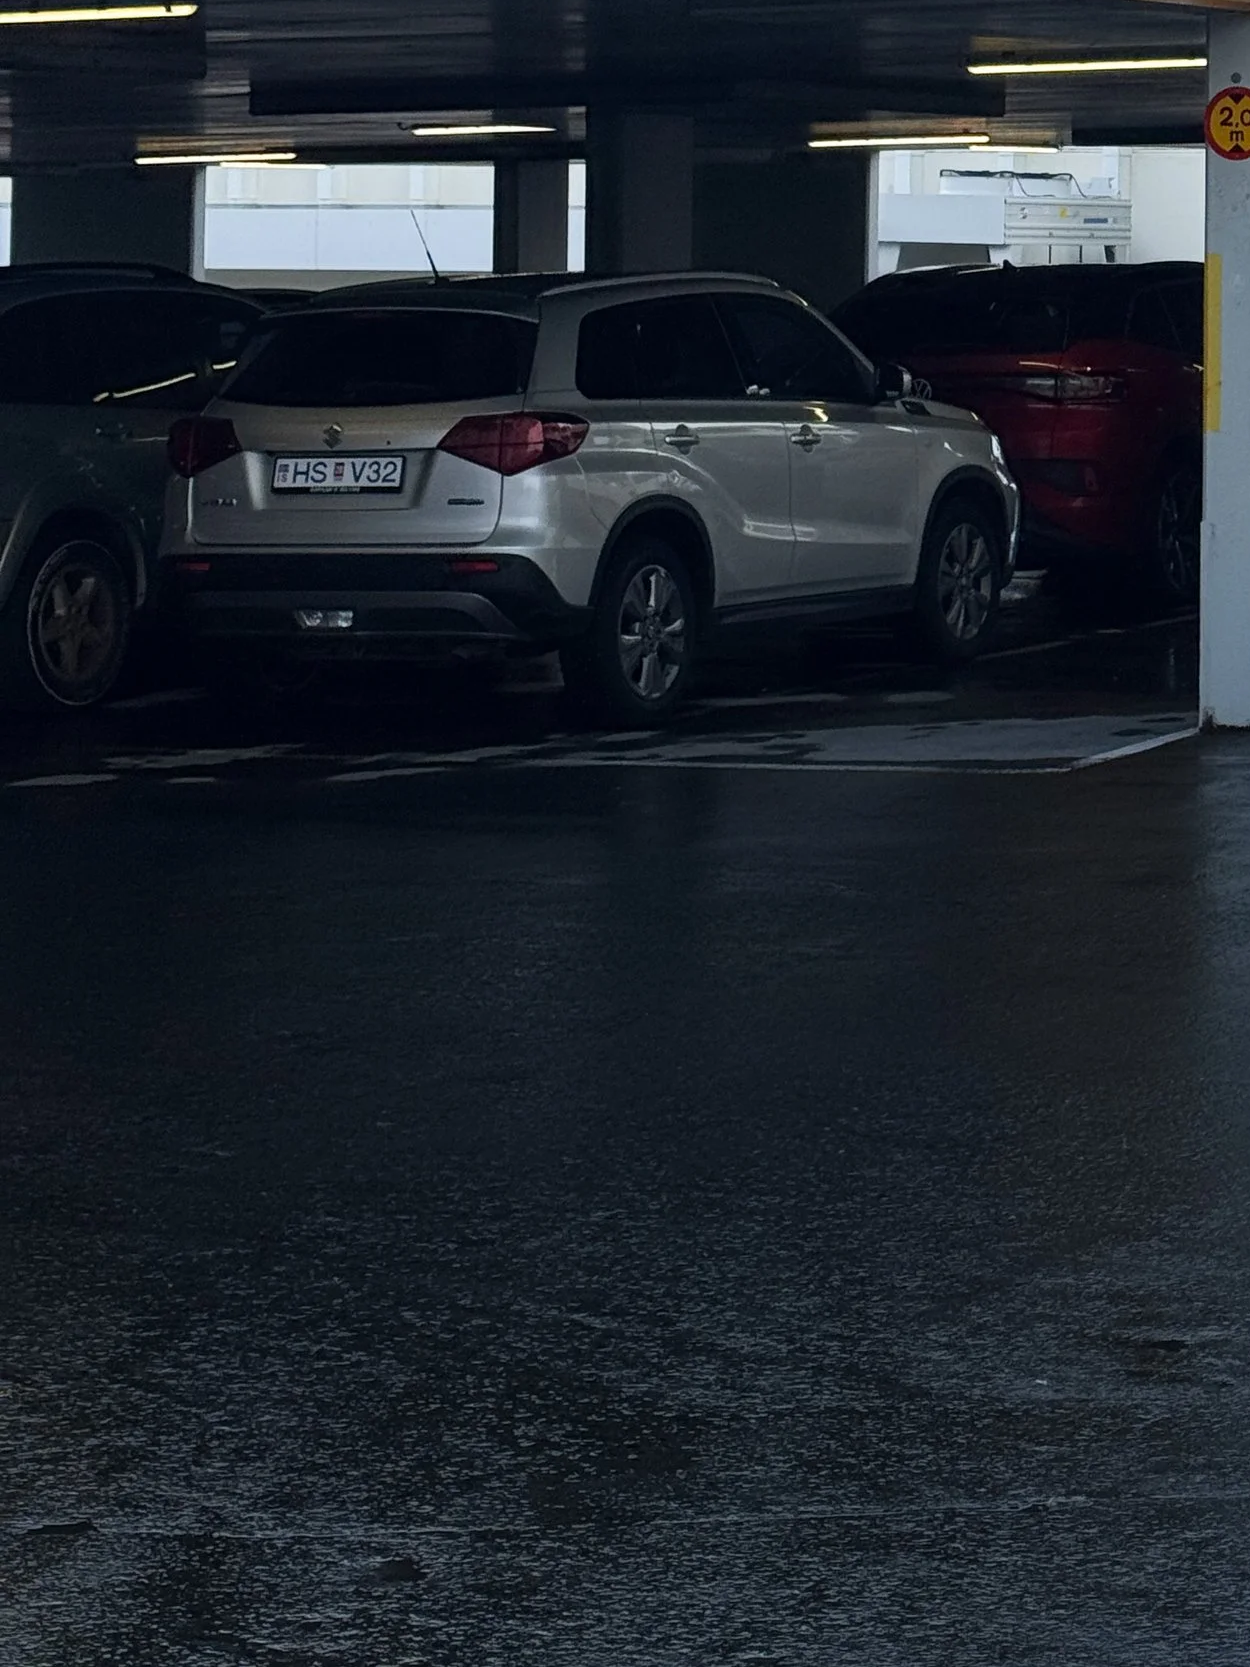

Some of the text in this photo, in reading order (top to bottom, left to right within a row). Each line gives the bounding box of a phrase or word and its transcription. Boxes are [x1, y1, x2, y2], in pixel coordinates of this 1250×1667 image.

[1229, 129, 1245, 142] m
[292, 460, 397, 484] HS V32
